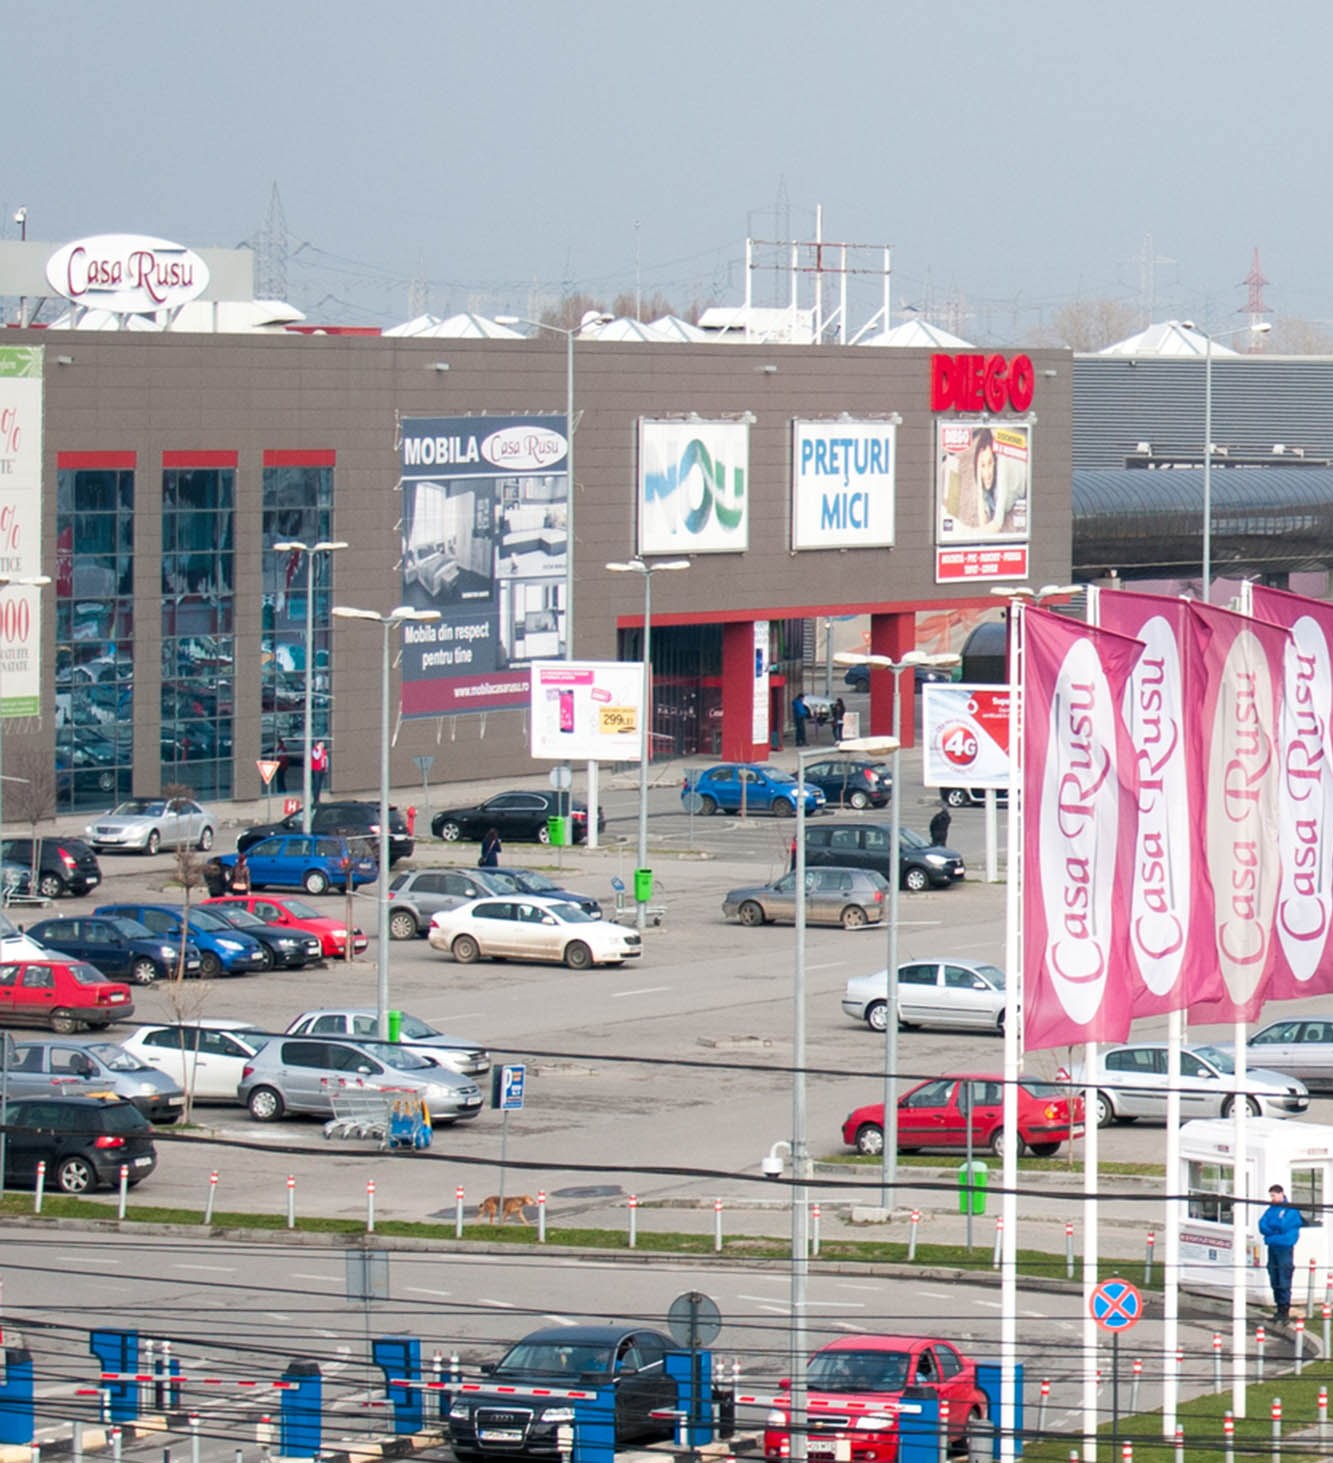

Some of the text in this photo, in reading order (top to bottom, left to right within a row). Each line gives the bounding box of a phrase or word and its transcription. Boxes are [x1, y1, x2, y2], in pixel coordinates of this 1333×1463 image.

[67, 246, 194, 304] Casa Rusu
[930, 353, 1035, 413] DIEGO
[404, 435, 560, 465] MOBILA Casa Rusu
[645, 438, 745, 535] NOU
[821, 492, 869, 530] MICI
[404, 621, 490, 643] Mobila din respect
[422, 648, 453, 670] pentru
[944, 730, 977, 757] 4G
[1135, 655, 1184, 961] Casa Rusu
[1218, 670, 1272, 966] Casa Rusu
[1281, 653, 1327, 943] Casa Rusu
[1051, 681, 1111, 984] Casa Rusu
